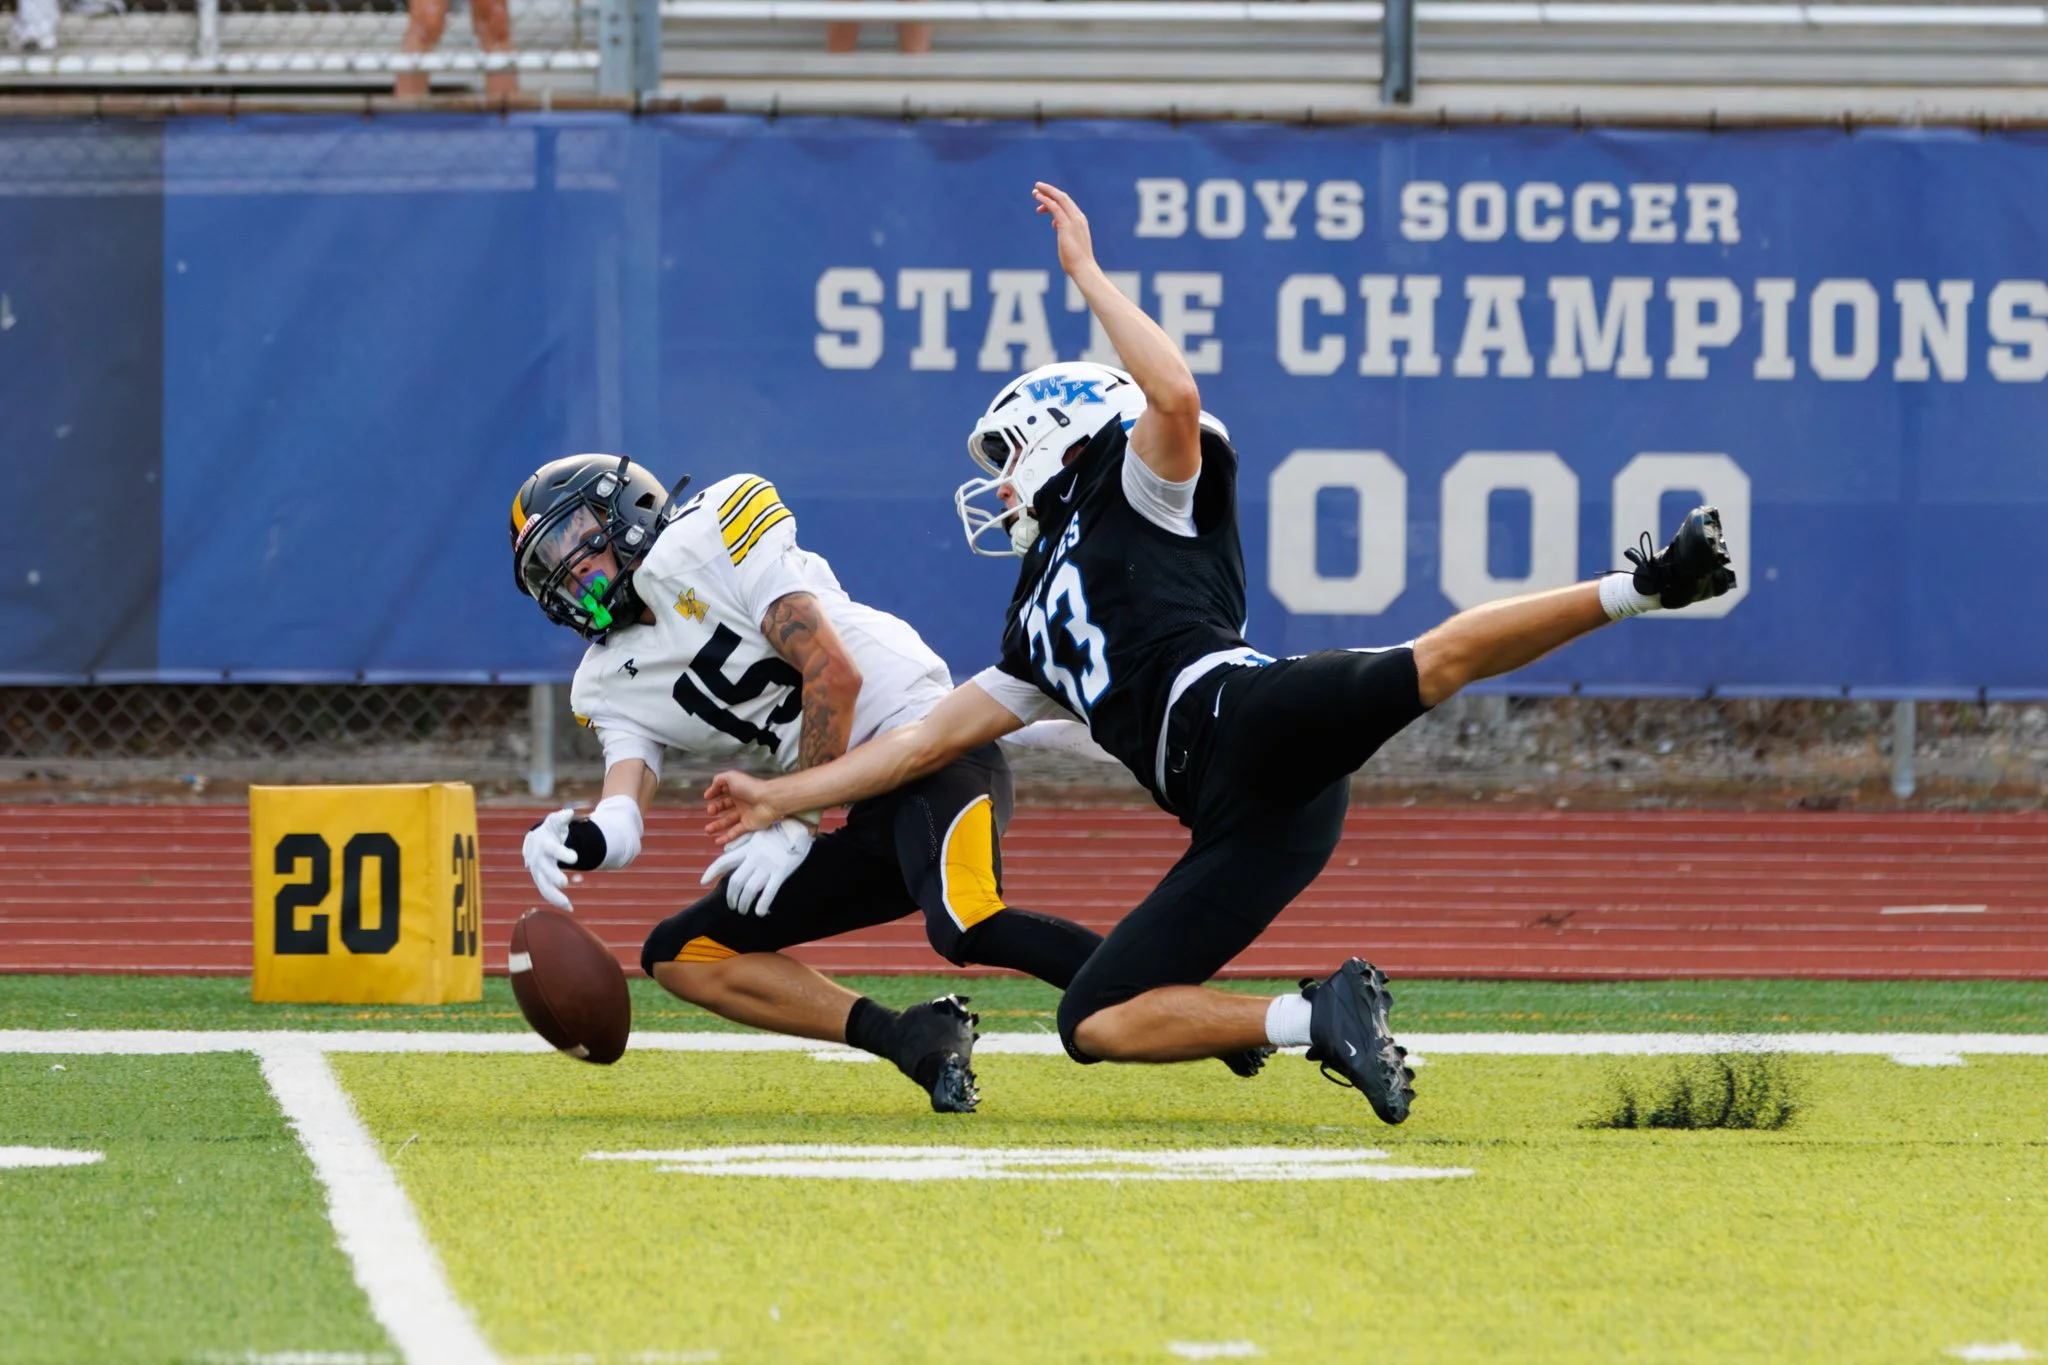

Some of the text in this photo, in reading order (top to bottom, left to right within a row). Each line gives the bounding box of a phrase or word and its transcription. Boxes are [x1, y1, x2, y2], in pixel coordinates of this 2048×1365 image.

[1135, 178, 1741, 244] BOYS SOCCER
[814, 267, 2048, 384] STATE CHAMPIONS
[1024, 375, 1106, 407] WK
[672, 622, 804, 755] 15
[1026, 559, 1112, 727] 33
[274, 833, 400, 955] 20
[453, 833, 477, 957] 20
